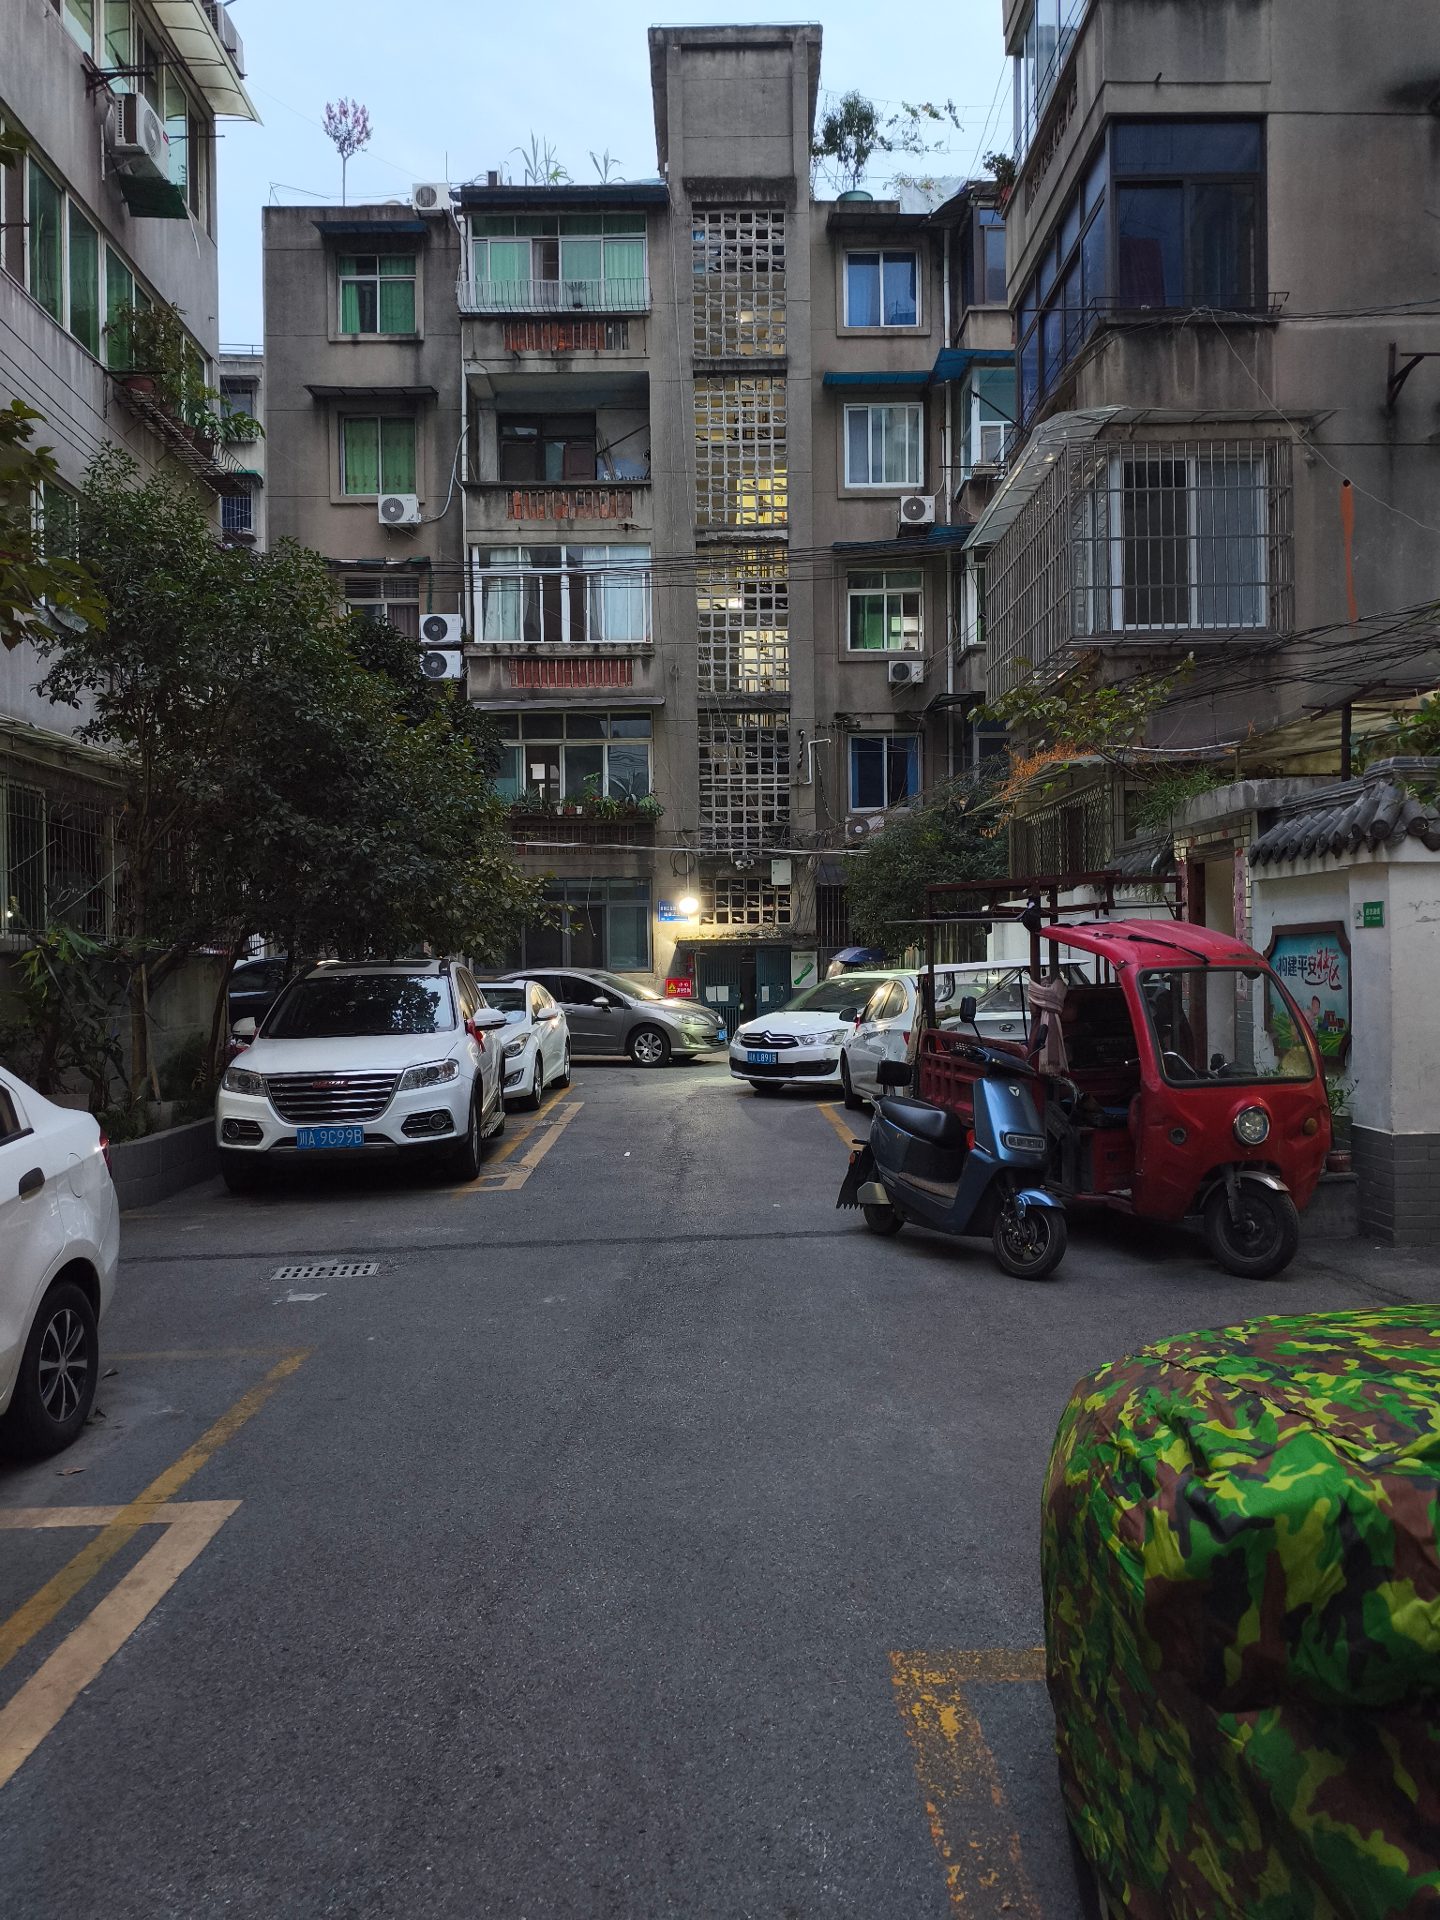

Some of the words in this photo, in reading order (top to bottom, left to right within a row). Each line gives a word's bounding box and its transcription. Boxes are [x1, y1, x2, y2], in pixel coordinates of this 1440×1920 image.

[1276, 947, 1343, 990] 构建平安社区
